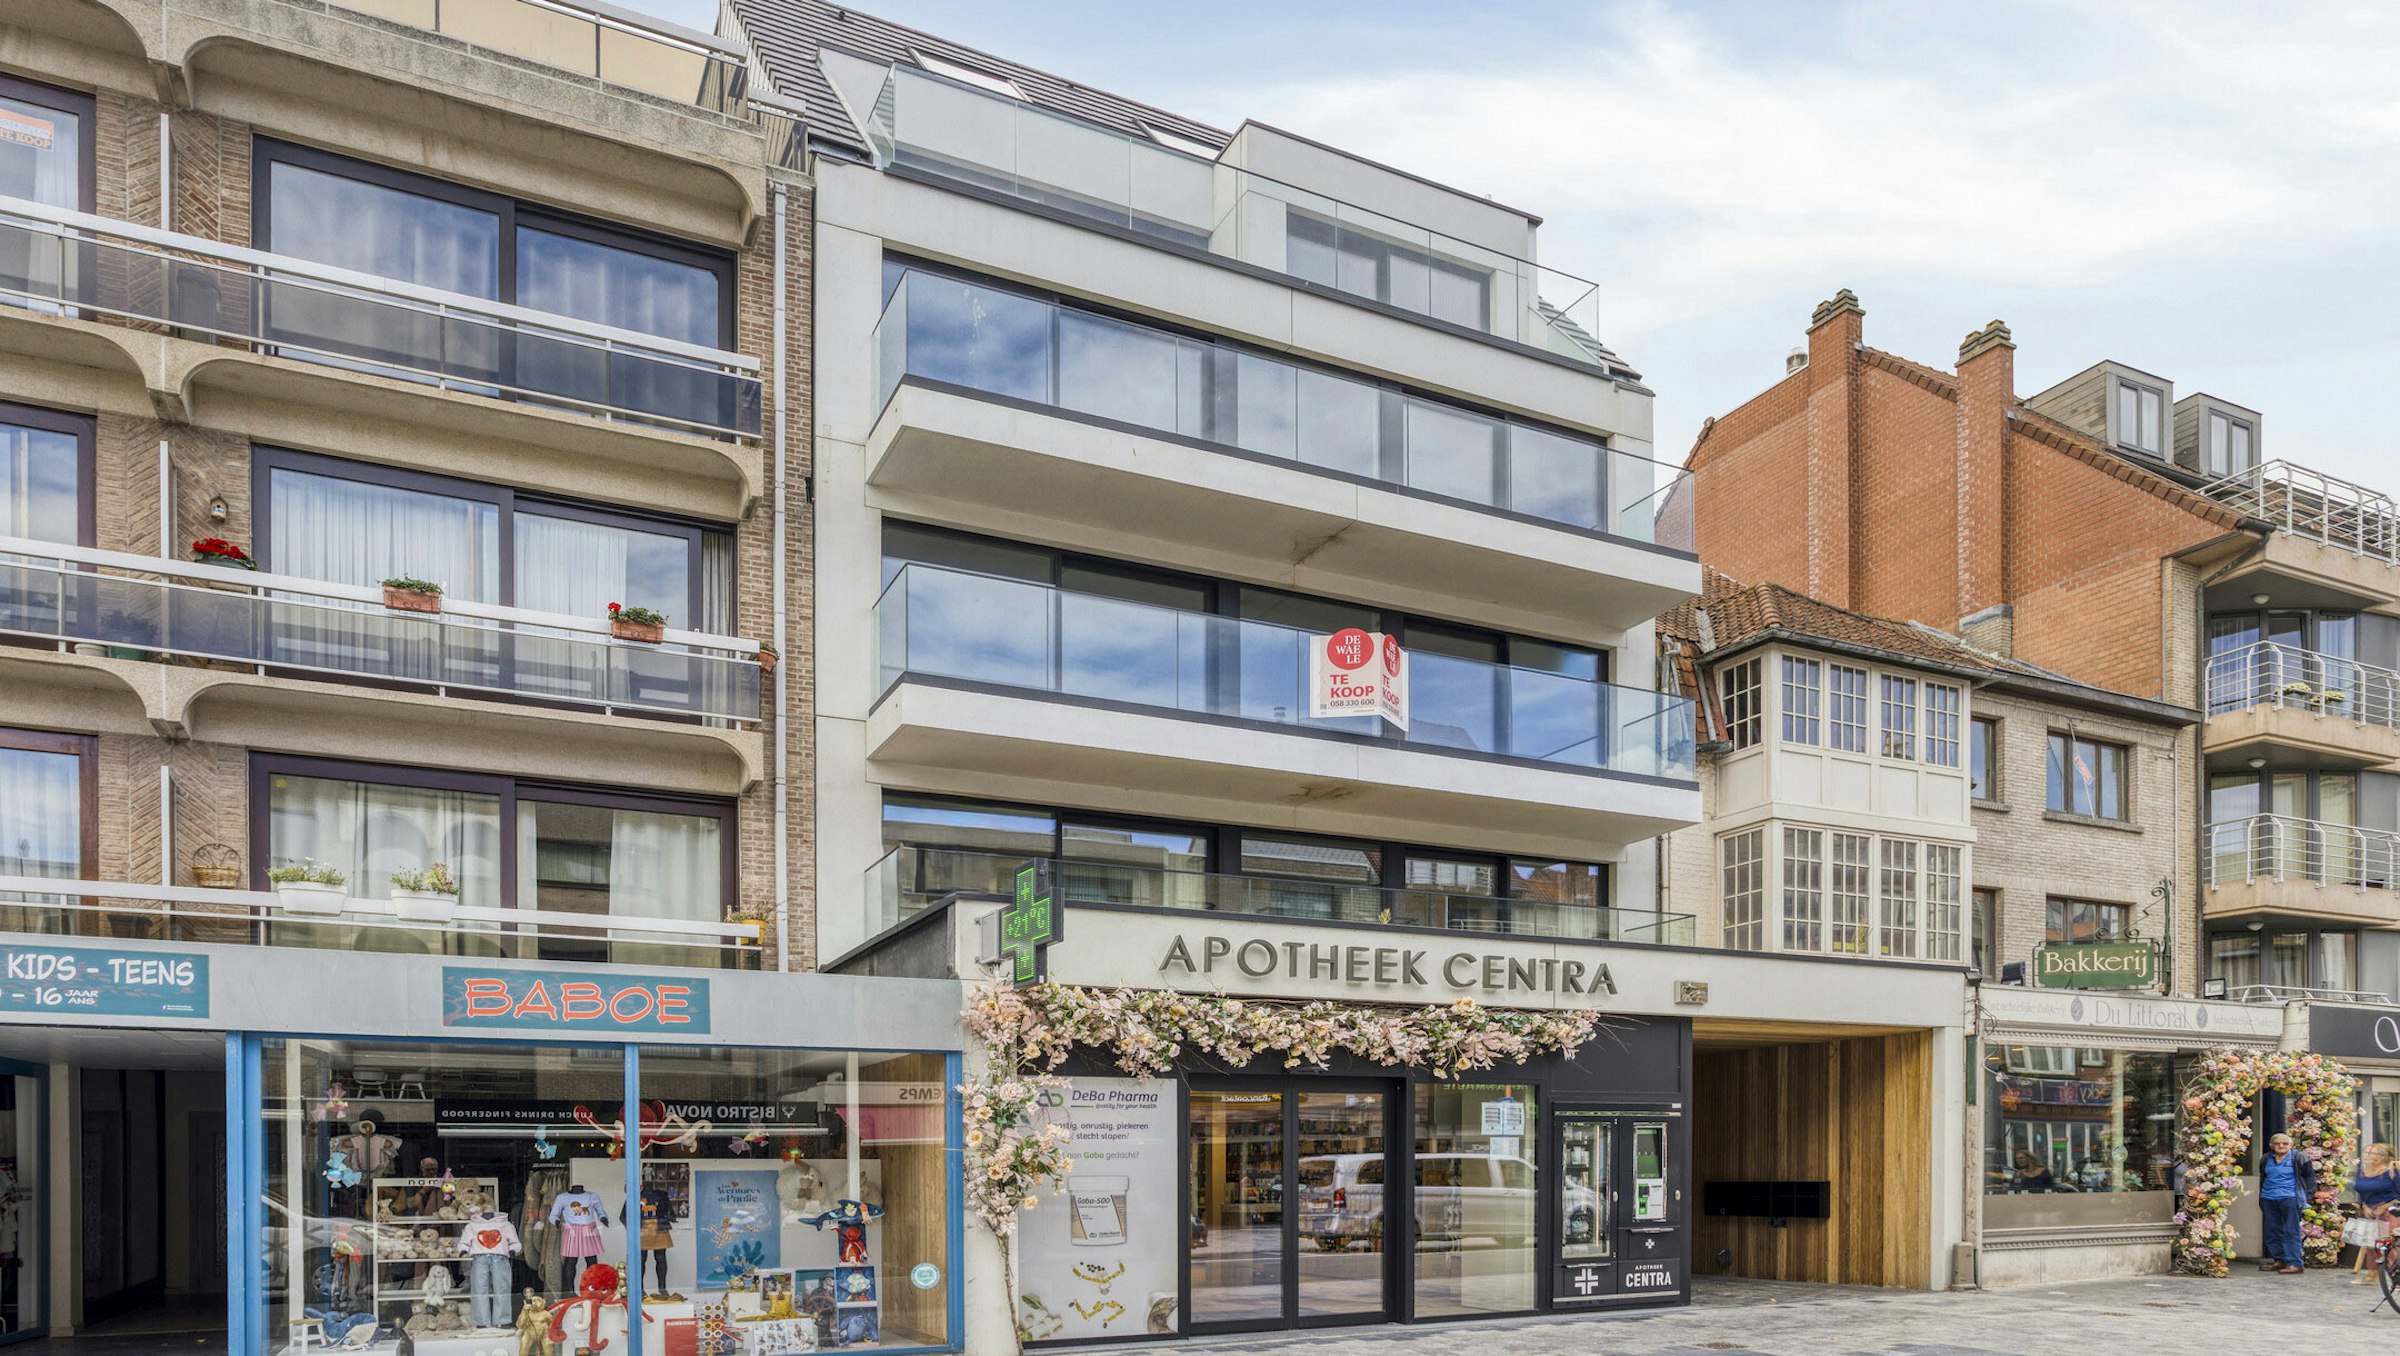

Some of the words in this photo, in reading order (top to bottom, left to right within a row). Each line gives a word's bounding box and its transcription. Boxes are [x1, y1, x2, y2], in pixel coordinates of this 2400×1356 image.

[16, 133, 52, 149] KOOP
[1345, 635, 1360, 644] DE
[1336, 645, 1360, 655] WAE
[1346, 655, 1360, 664] LE
[1329, 674, 1349, 685] TE
[1330, 686, 1375, 698] KOOP
[1158, 934, 1428, 986] APOTHEEK
[1443, 952, 1618, 996] CENTRA
[2044, 949, 2147, 978] Bakkerij
[8, 953, 77, 981] KIDS
[108, 958, 194, 986] TEENS
[35, 986, 62, 1005] 16
[65, 989, 98, 998] JAAR
[68, 996, 96, 1005] ANS
[465, 978, 691, 1024] BABOE
[2095, 1000, 2120, 1025] Du
[2128, 1002, 2187, 1028] Littoral
[1072, 1090, 1105, 1101] DeBa
[1109, 1090, 1158, 1102] Pharma
[1117, 1122, 1149, 1130] piekeren
[1076, 1132, 1100, 1140] slecht
[1083, 1151, 1104, 1159] Gaba
[1106, 1151, 1140, 1161] gedacht?
[1077, 1197, 1111, 1205] Gaba-500
[1625, 1271, 1672, 1287] CENTRA
